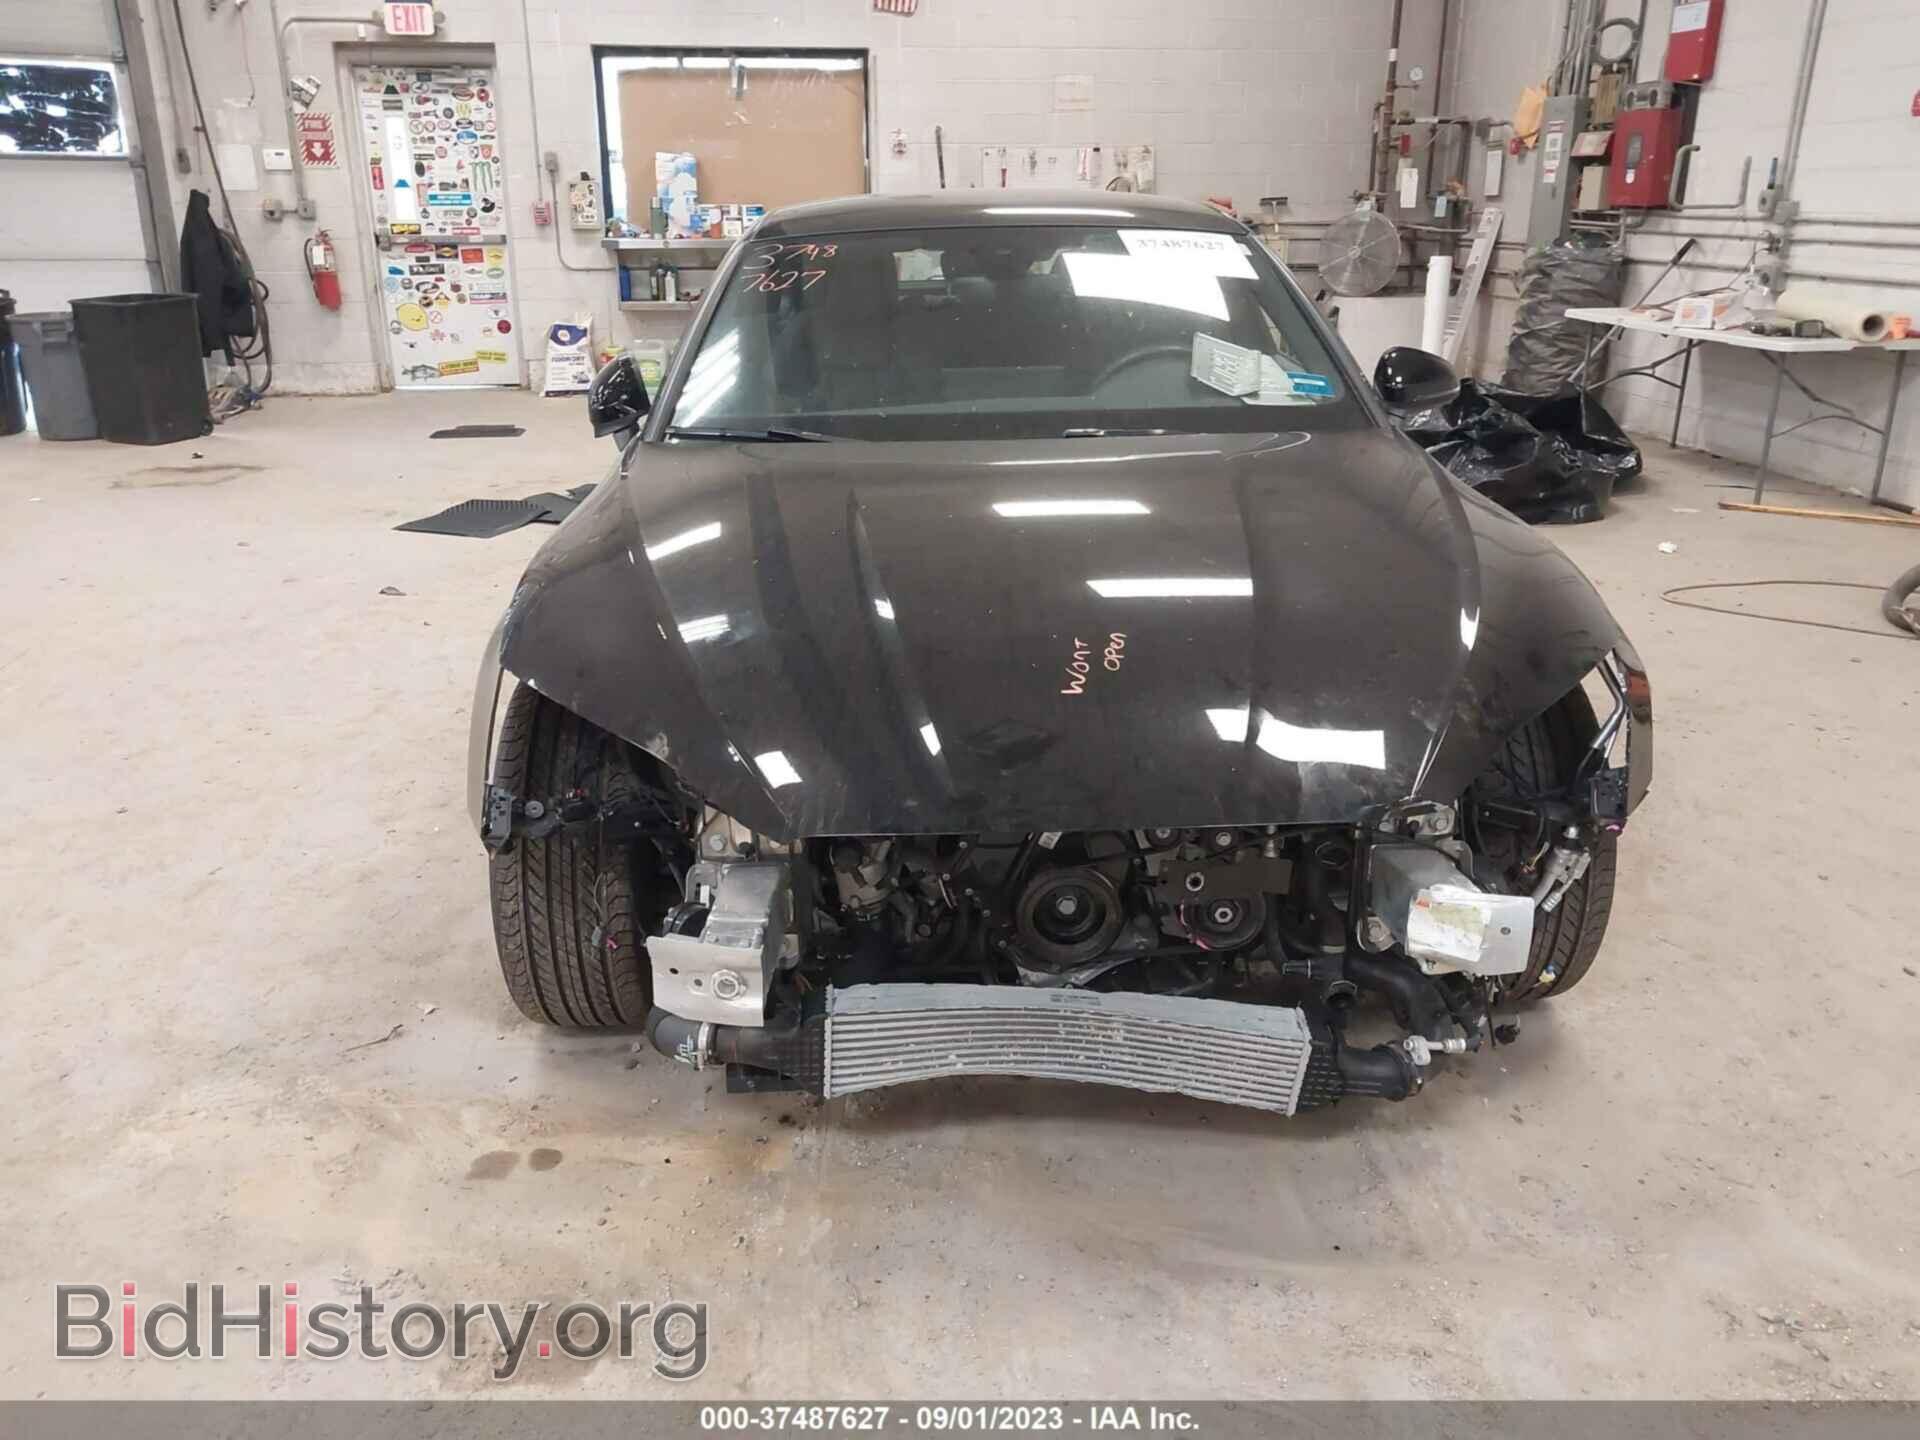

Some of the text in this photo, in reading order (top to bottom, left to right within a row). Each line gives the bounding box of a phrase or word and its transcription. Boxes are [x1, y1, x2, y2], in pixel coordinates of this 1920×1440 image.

[391, 5, 425, 32] EXIT
[743, 243, 839, 270] 3748
[740, 269, 828, 293] 7627
